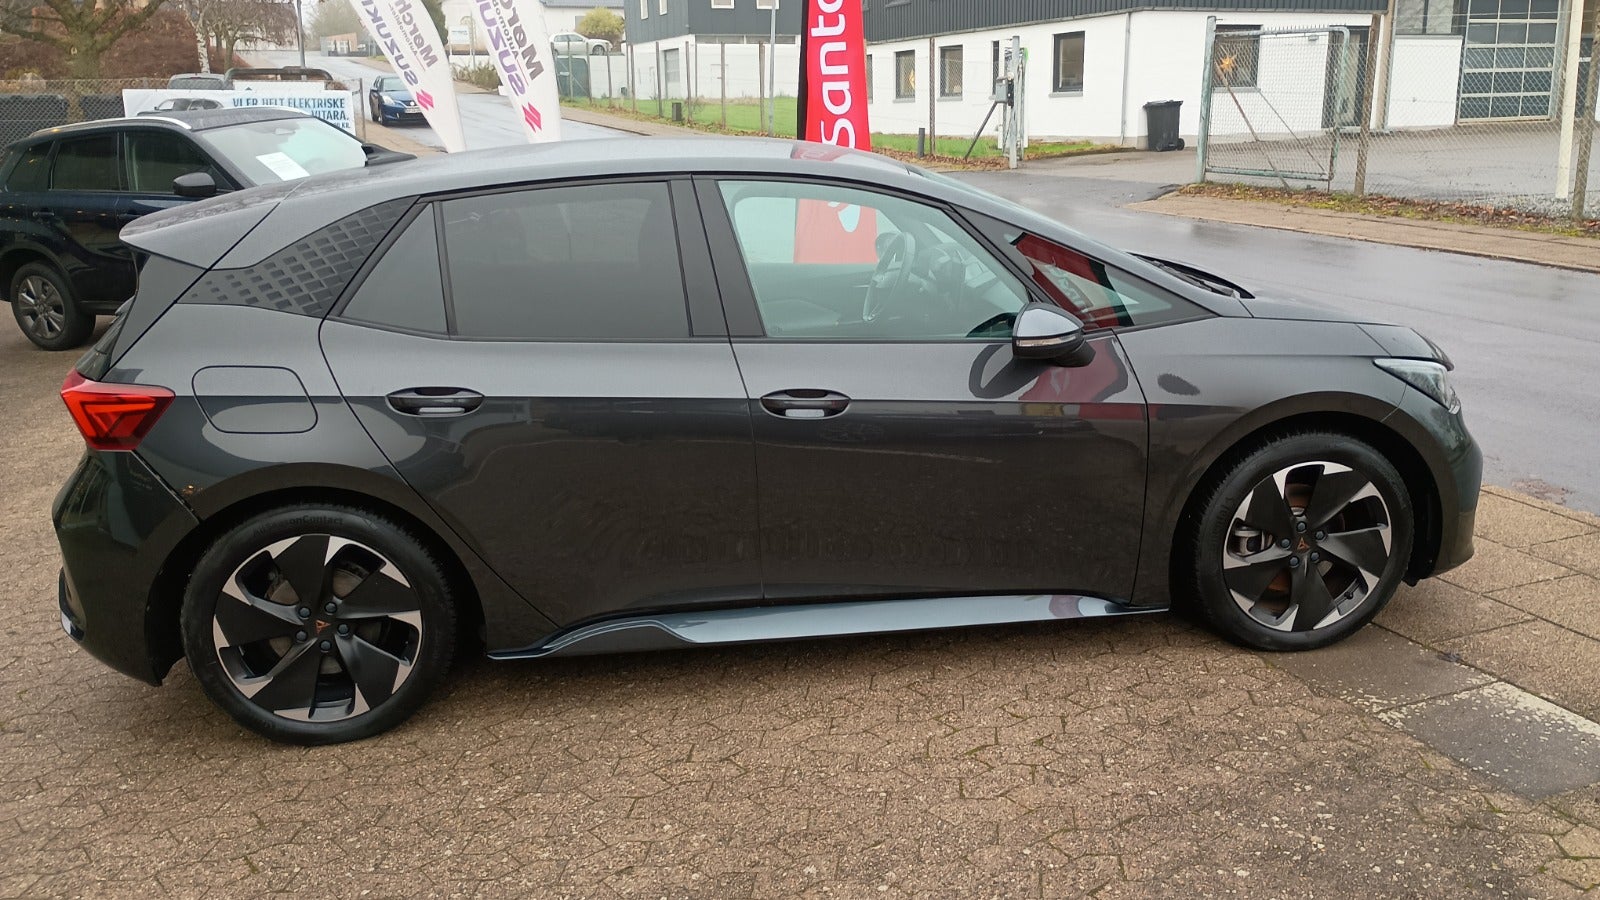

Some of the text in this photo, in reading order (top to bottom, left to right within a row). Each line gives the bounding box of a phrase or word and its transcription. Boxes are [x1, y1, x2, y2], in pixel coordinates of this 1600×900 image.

[811, 0, 855, 148] Sant
[232, 97, 243, 107] VI
[287, 97, 345, 108] ELEKTRISKE
[311, 110, 349, 120] VITARA.
